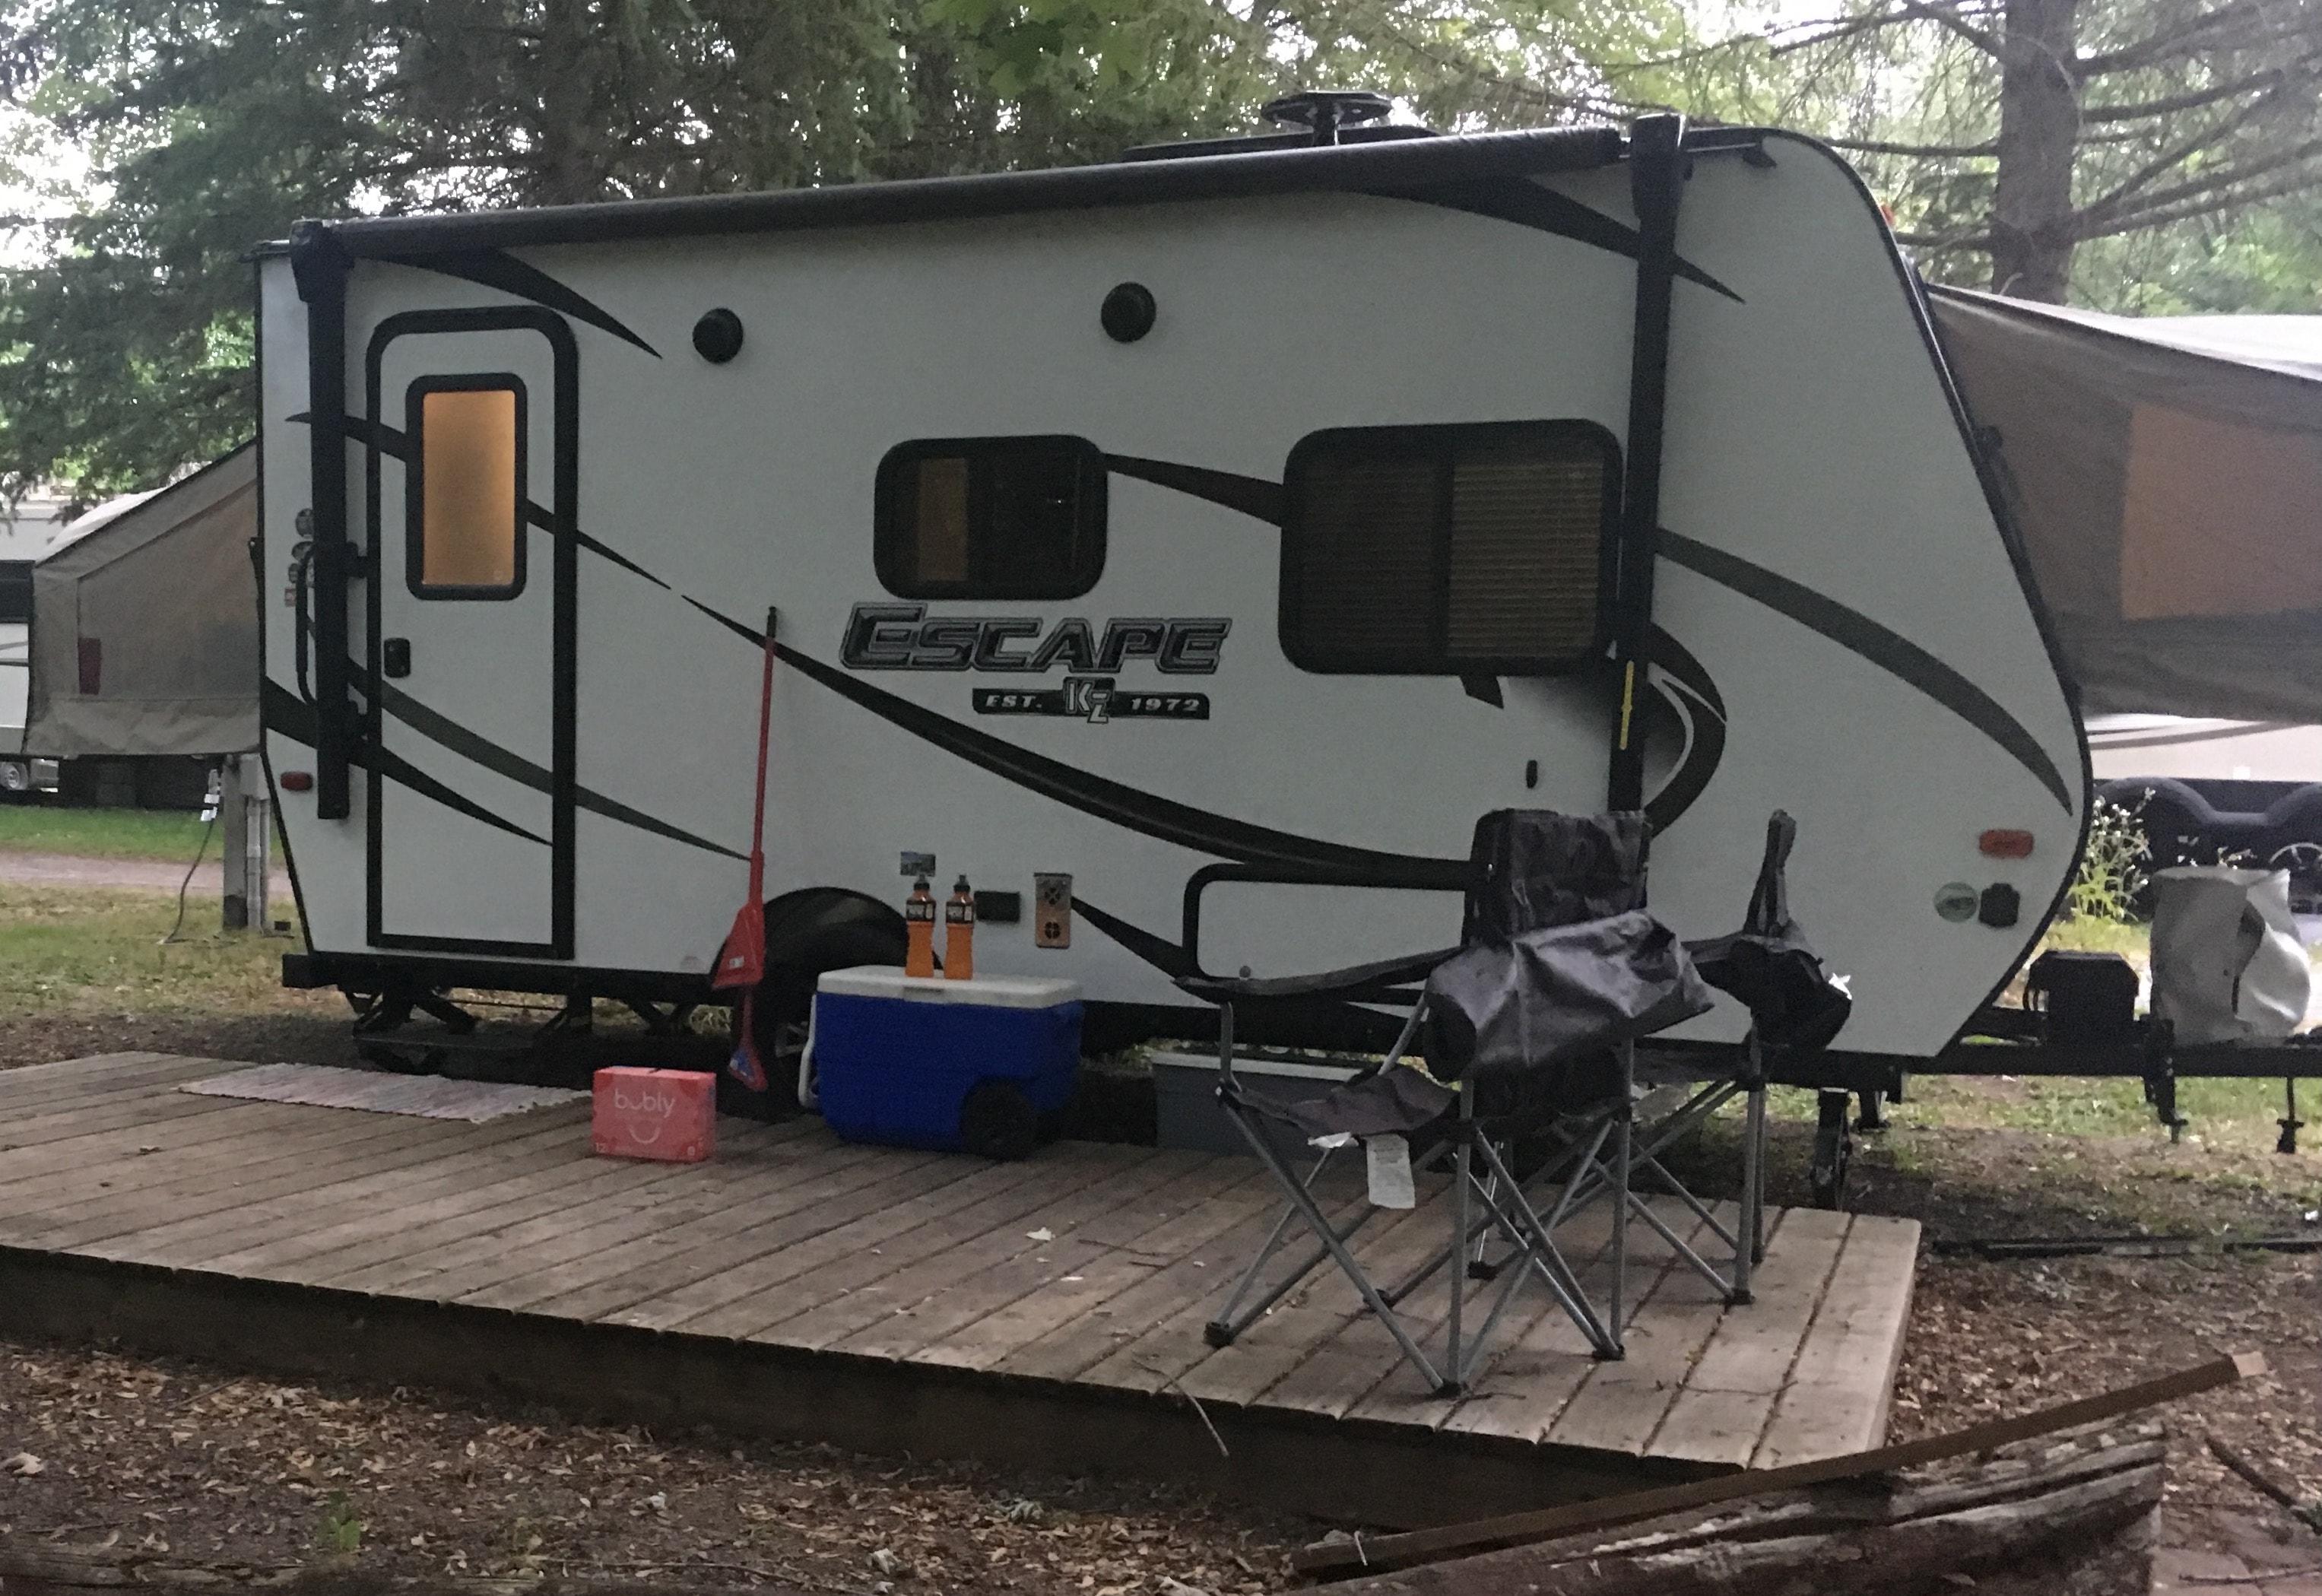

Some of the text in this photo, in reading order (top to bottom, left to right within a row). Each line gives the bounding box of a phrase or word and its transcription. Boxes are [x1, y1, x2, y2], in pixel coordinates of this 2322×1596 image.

[839, 601, 1232, 674] ESCAPE
[985, 694, 1042, 709] EST.
[1131, 696, 1201, 712] 1972
[614, 1087, 676, 1118] bubly
